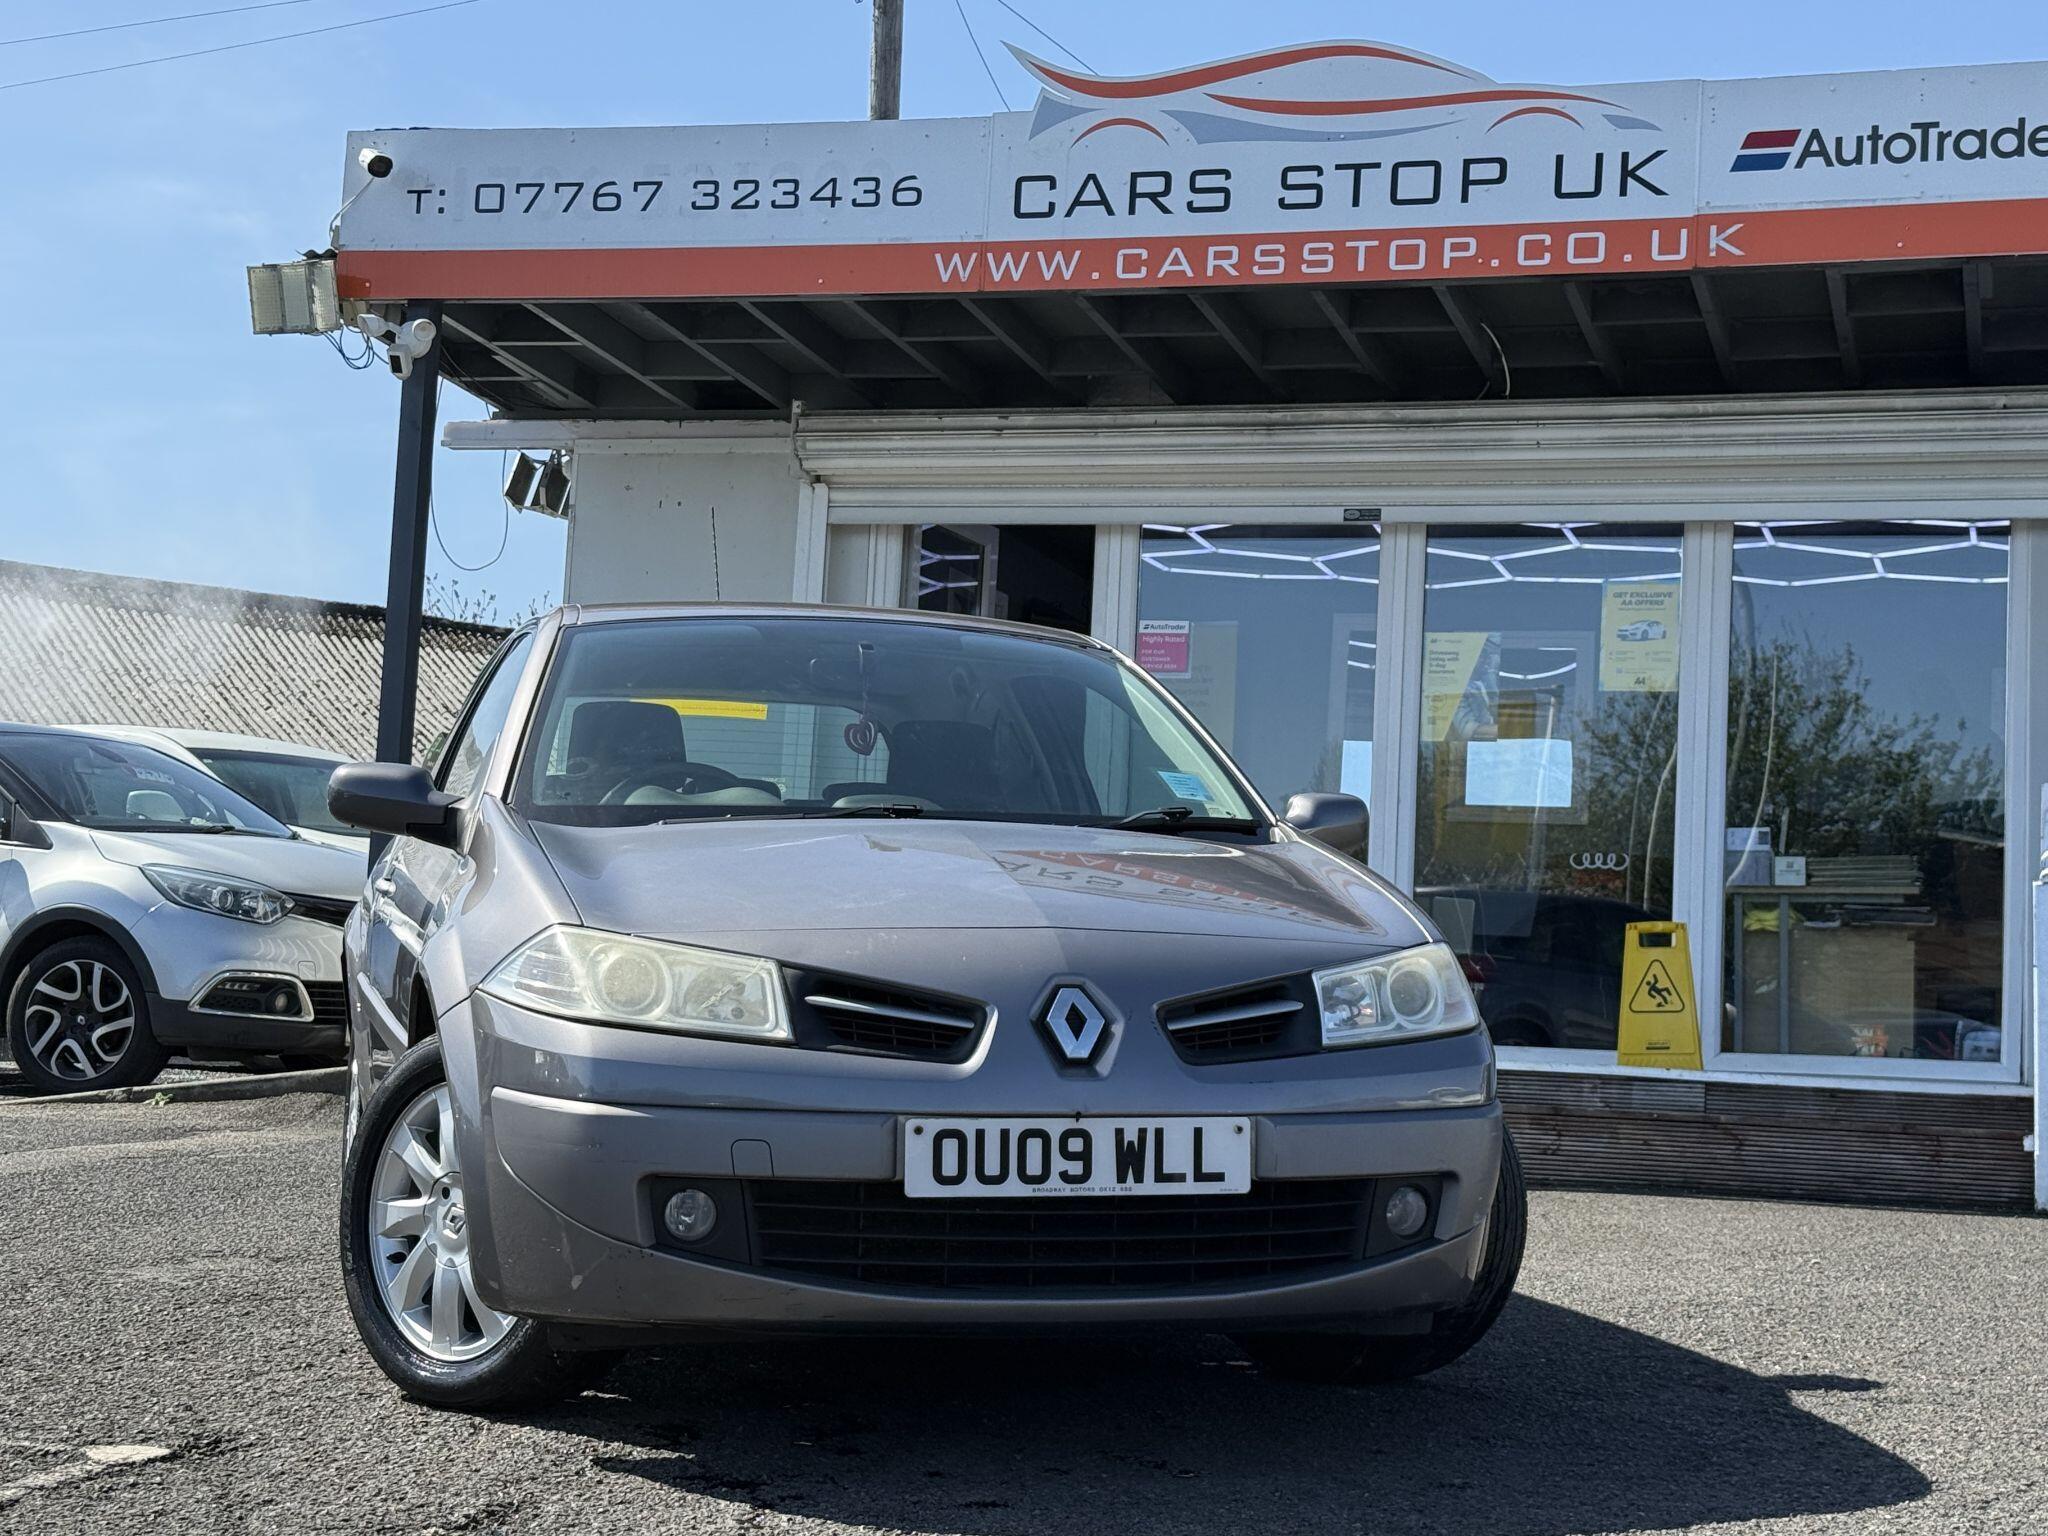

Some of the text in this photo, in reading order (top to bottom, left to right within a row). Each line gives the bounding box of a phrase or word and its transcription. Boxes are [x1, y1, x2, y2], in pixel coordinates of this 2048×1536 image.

[1793, 117, 2048, 170] AutoTrade
[406, 175, 923, 215] T: 07767 323436
[1013, 149, 1669, 219] CARS STOP UK
[1142, 635, 1163, 644] Highly
[932, 1126, 1226, 1186] OU09 WLL
